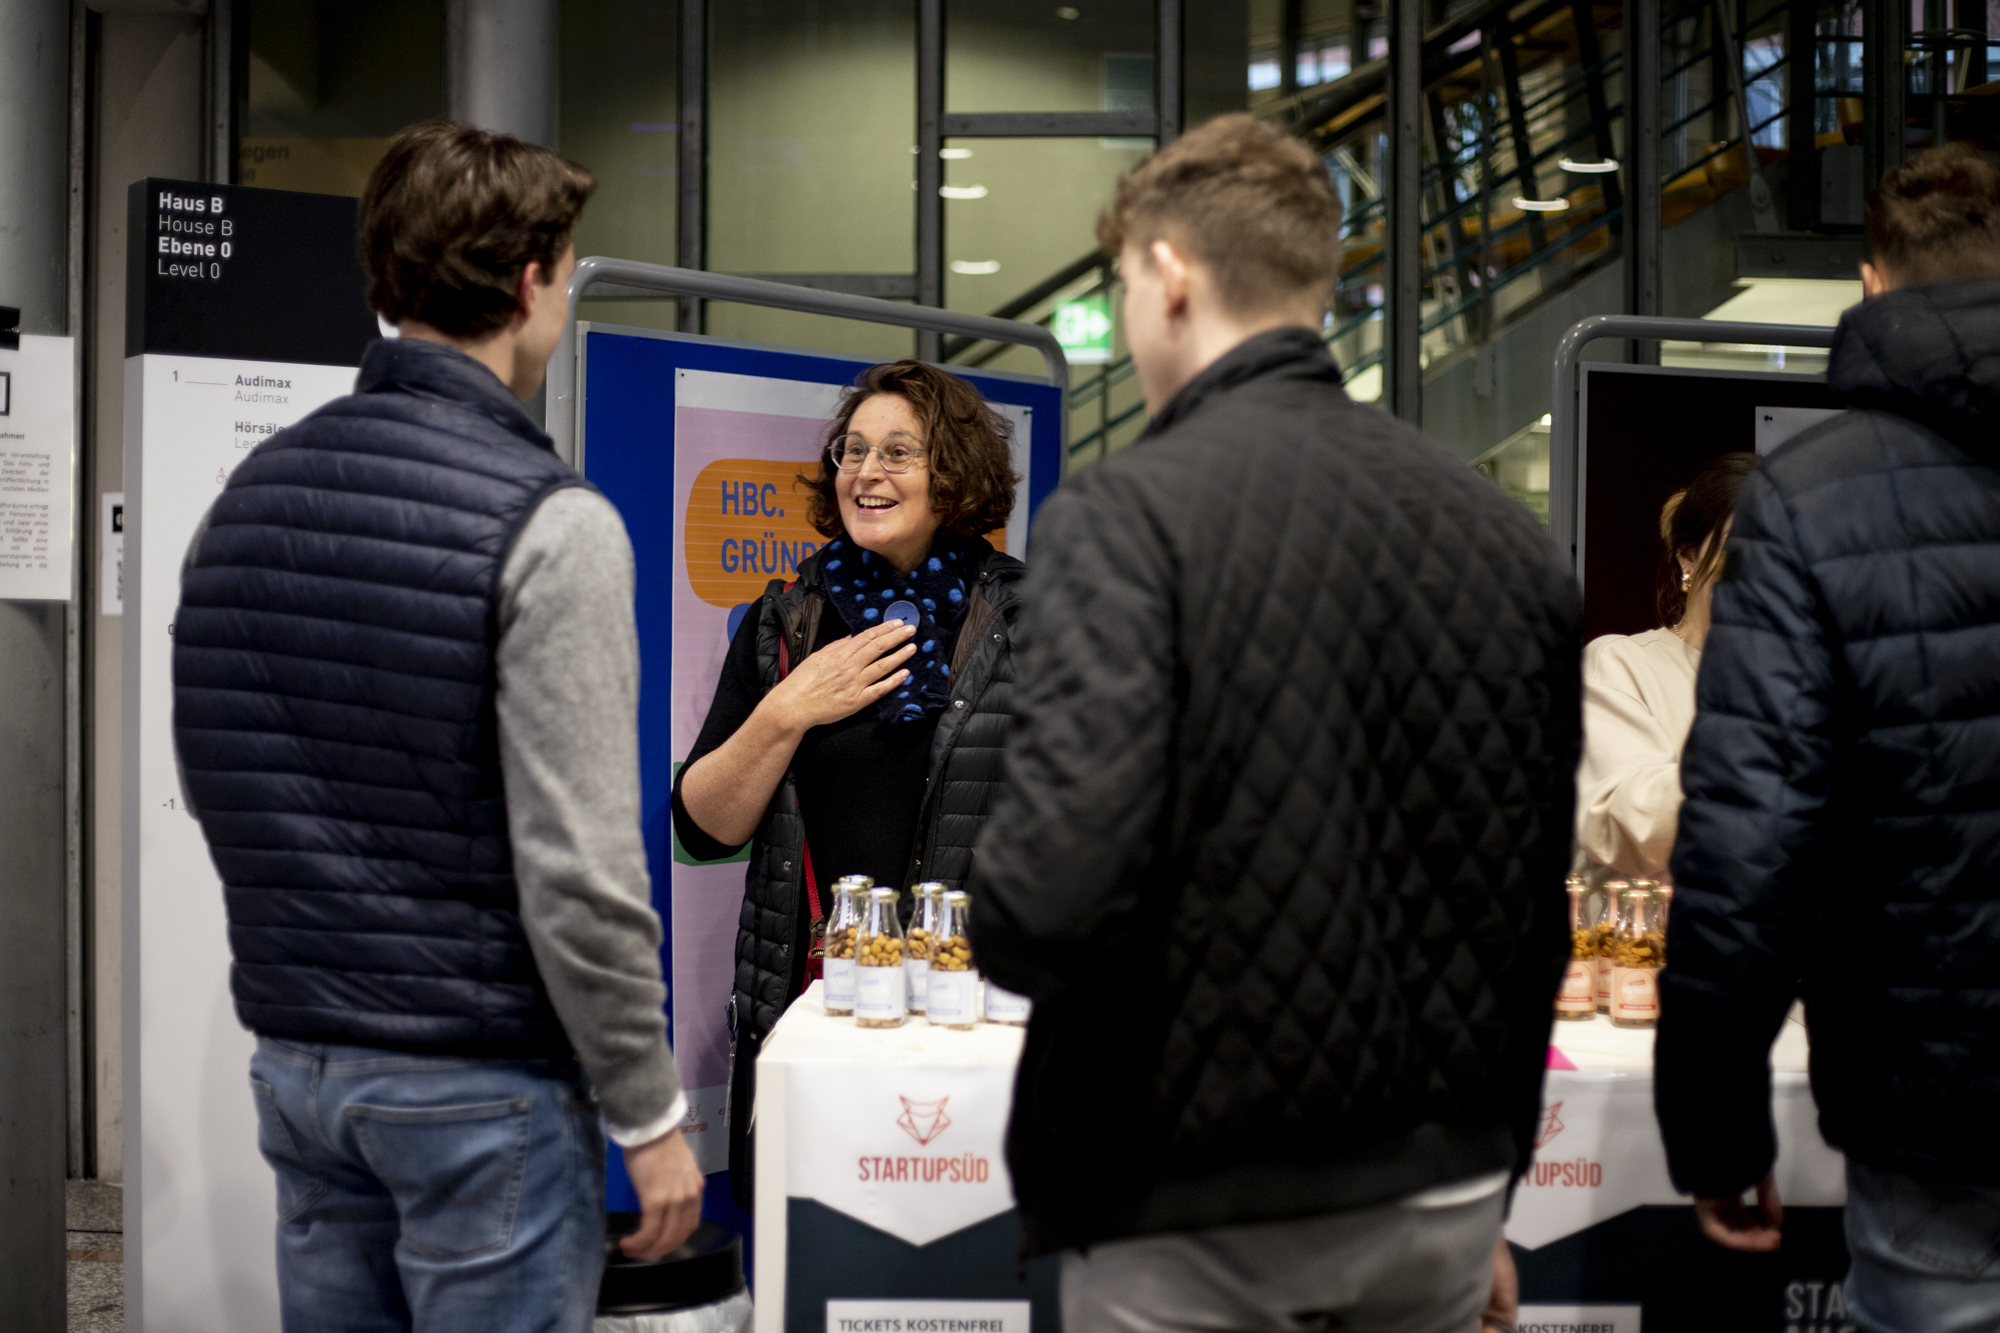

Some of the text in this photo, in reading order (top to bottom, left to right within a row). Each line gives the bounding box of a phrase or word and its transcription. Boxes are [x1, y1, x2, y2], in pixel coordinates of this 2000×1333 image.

[159, 191, 224, 213] Haus B
[158, 213, 233, 236] House B
[158, 236, 232, 258] Ebene 0
[158, 258, 220, 279] Level 0
[172, 370, 292, 389] 1 Audimax
[234, 390, 289, 404] Audimax
[10, 452, 50, 461] Veranstaltung
[721, 480, 785, 518] HBC.
[721, 531, 829, 575] GRÜND
[162, 798, 175, 810] -1
[858, 1151, 989, 1183] STARTUPSÜD
[1524, 1157, 1603, 1188] UPSÜD
[838, 1318, 1004, 1333] TICKETS KOSTENFREI
